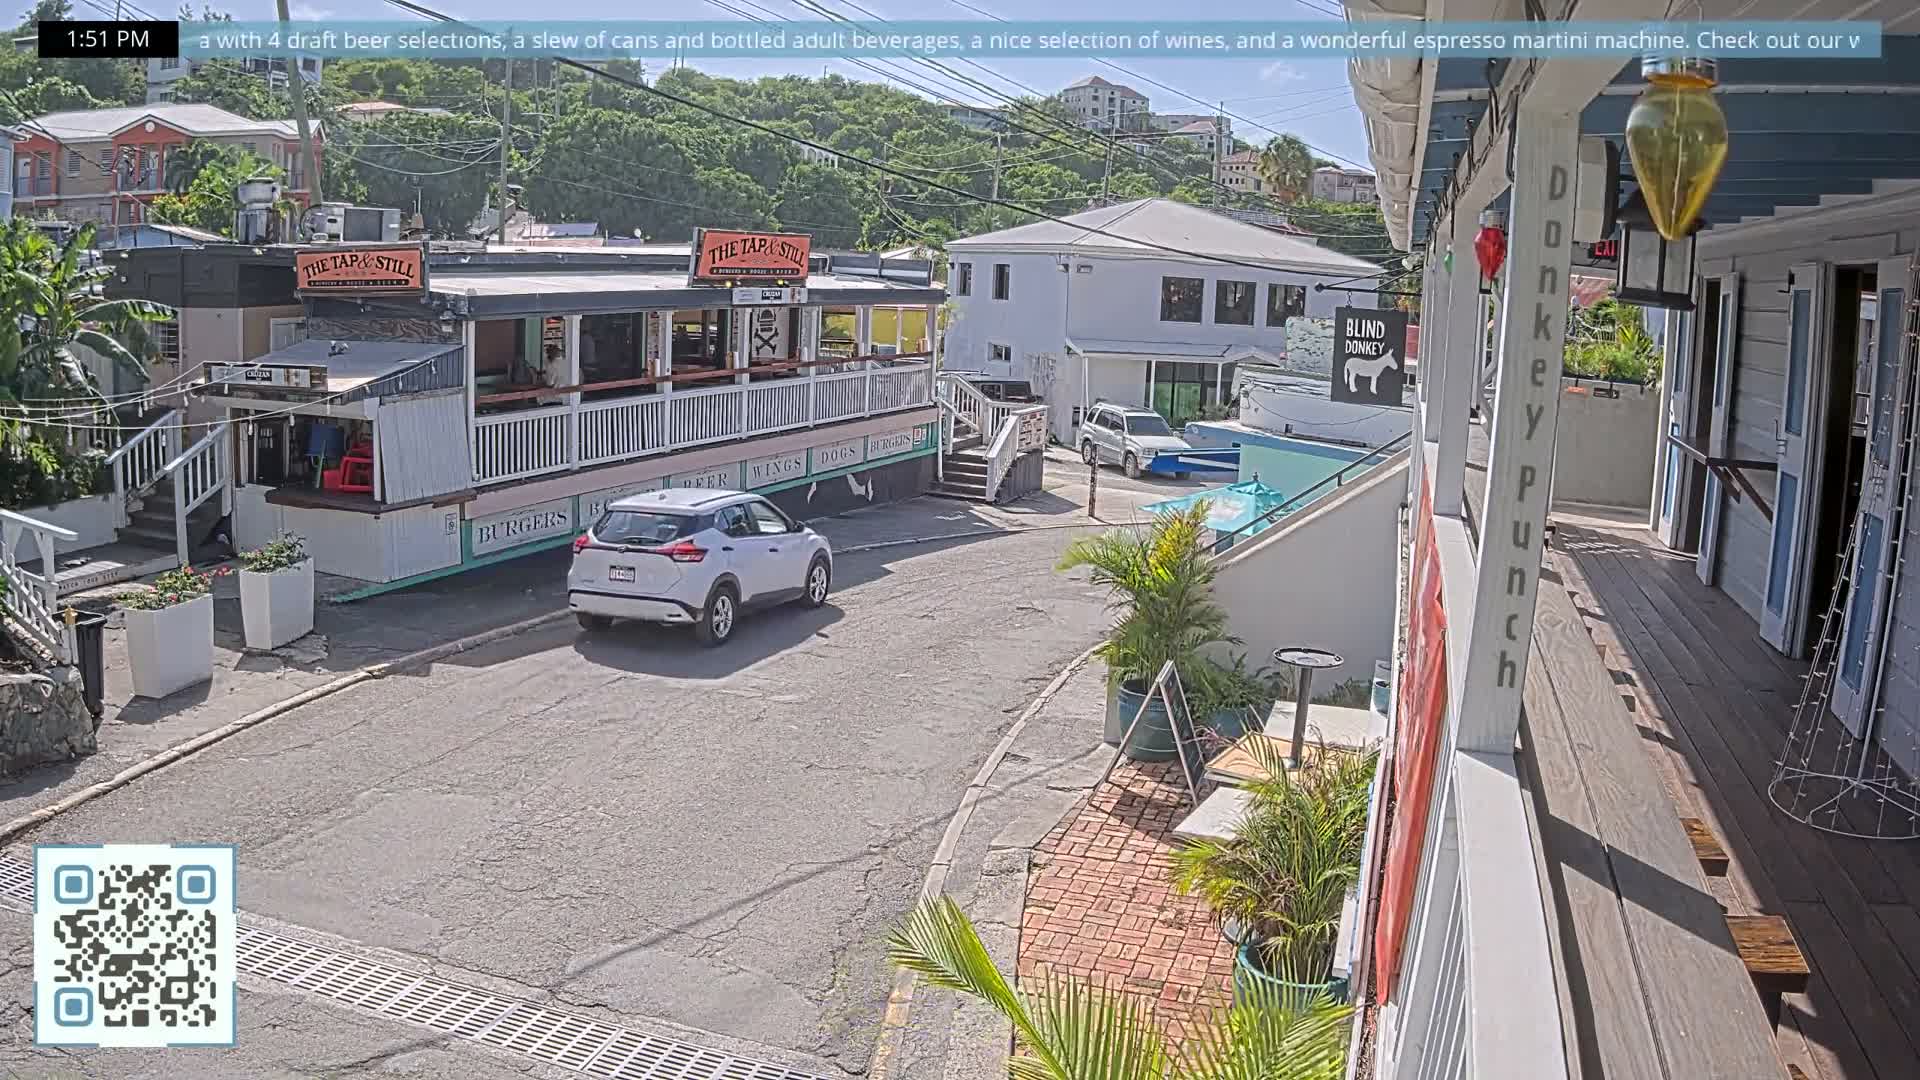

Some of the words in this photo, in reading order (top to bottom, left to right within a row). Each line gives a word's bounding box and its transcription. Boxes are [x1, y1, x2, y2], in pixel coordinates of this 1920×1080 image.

[709, 241, 739, 265] THE
[741, 238, 767, 255] TAP
[779, 242, 804, 268] STILL
[303, 259, 330, 279] THE
[330, 254, 359, 272] TAP
[375, 256, 415, 279] STILL
[1346, 318, 1386, 339] BLIND
[1345, 339, 1385, 355] DONKEY
[869, 432, 911, 453] BURGERS
[821, 447, 856, 465] DOGS
[752, 457, 801, 480] WINGS
[478, 510, 568, 544] BURGERS
[1497, 464, 1537, 689] punch
